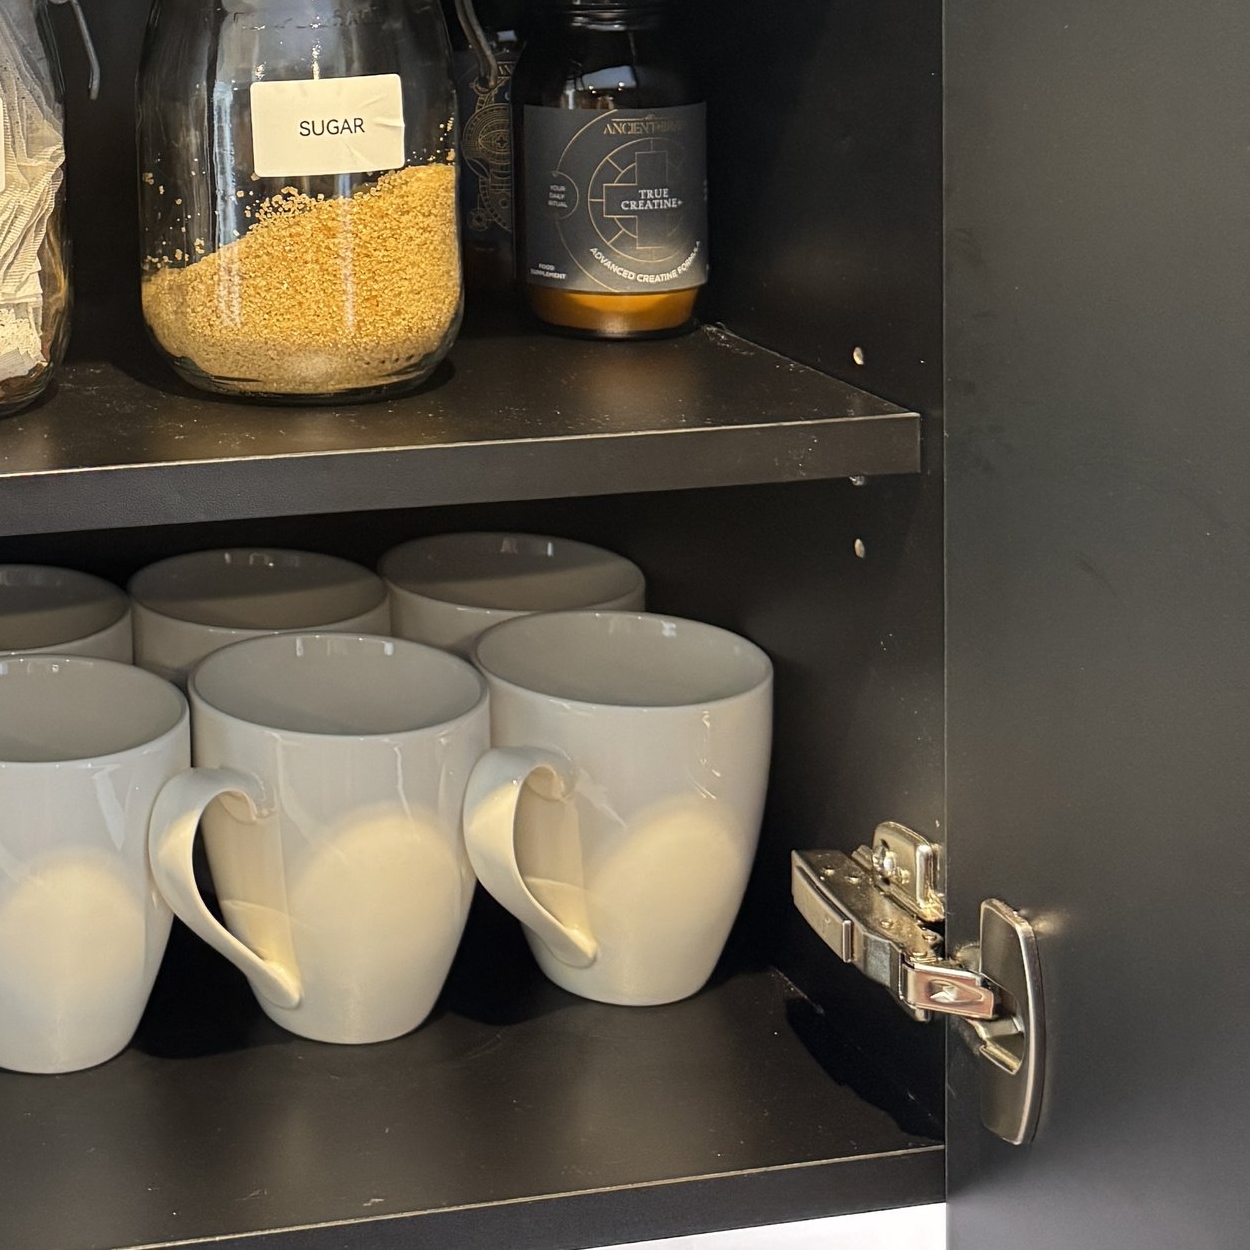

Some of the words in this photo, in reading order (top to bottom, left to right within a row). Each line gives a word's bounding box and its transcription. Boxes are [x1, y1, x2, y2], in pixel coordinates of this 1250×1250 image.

[299, 117, 366, 137] SUGAR
[638, 188, 669, 199] TRUE
[590, 247, 636, 281] ADVANCED
[636, 269, 678, 283] CREATINE
